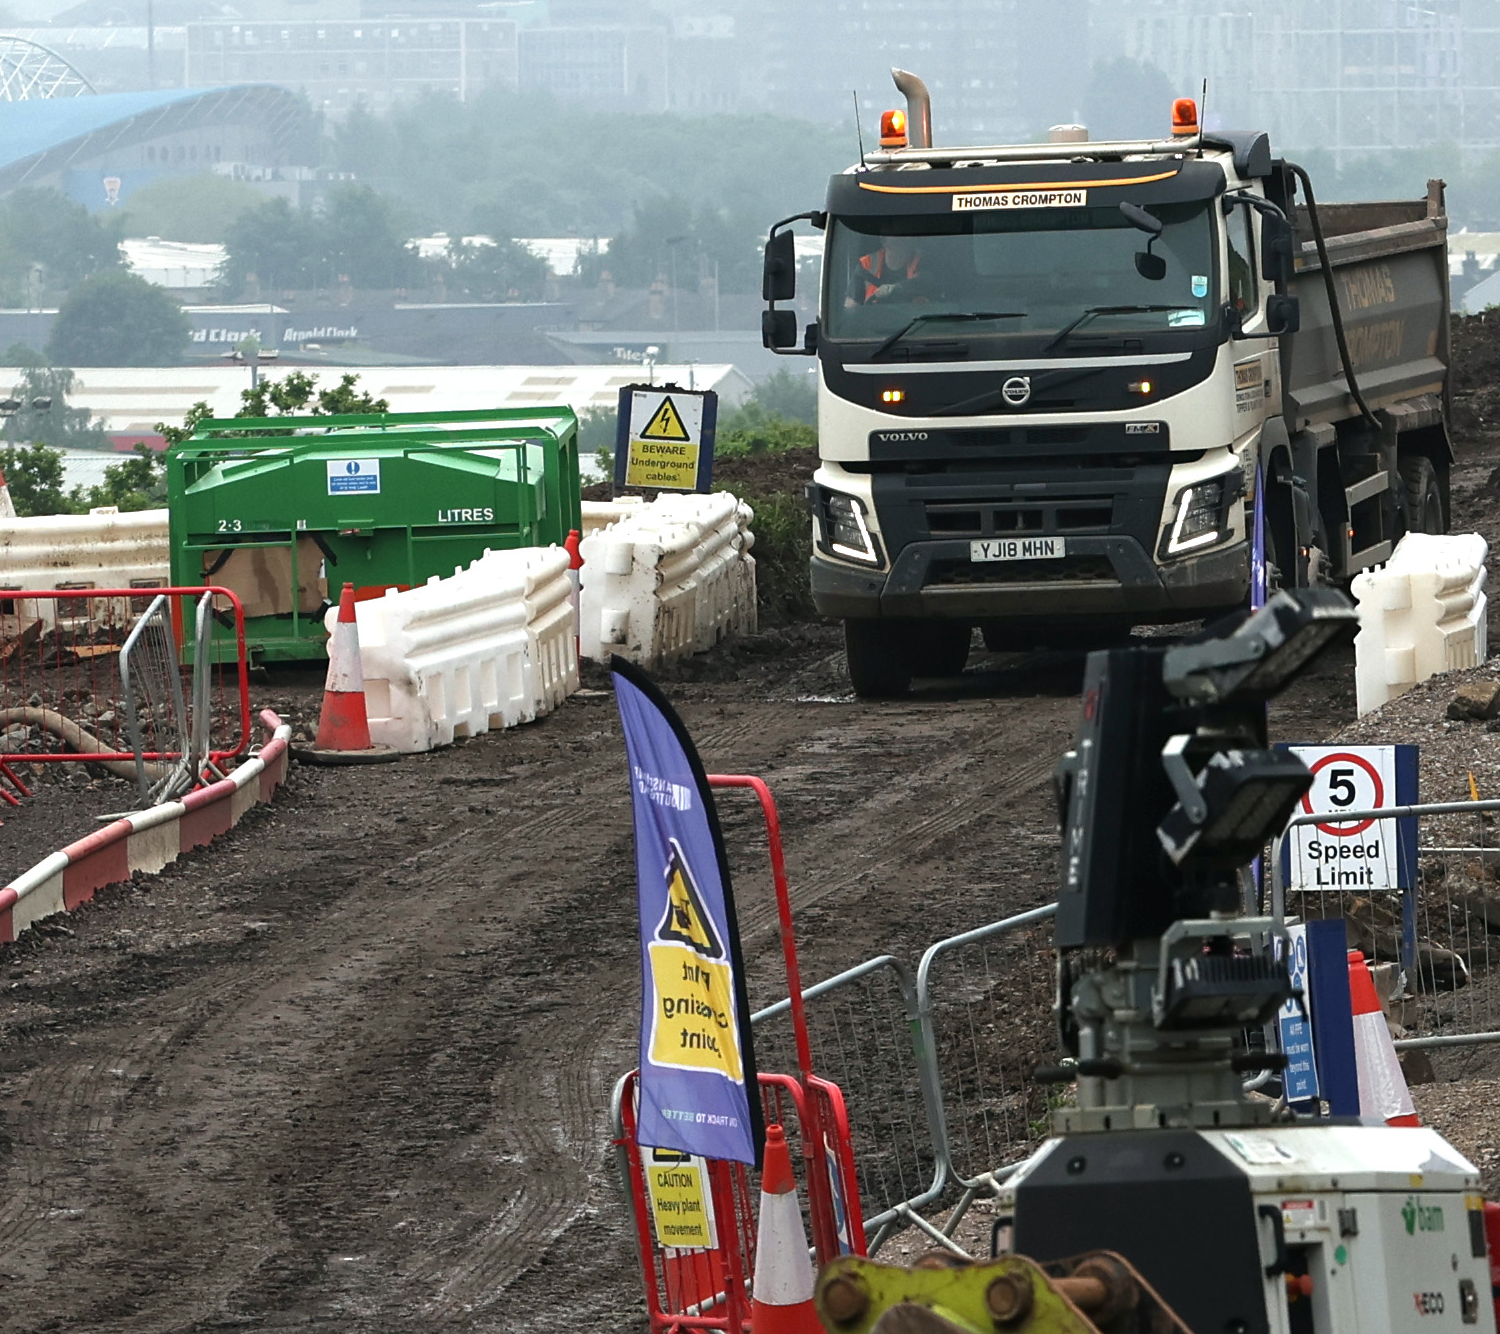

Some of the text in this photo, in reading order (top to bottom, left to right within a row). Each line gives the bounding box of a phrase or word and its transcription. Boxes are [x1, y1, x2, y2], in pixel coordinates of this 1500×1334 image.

[956, 192, 1082, 208] THOMAS CROMPTON
[209, 328, 262, 343] Clark
[283, 327, 326, 342] Arnold
[878, 431, 929, 442] VOLVO
[641, 444, 687, 456] BEWARE
[631, 457, 695, 470] Underground
[645, 472, 678, 482] cables
[438, 507, 494, 522] LITRES
[981, 540, 1055, 558] YJ18 MHN
[1328, 769, 1356, 807] 5
[1307, 839, 1380, 864] Speed
[1316, 866, 1374, 886] Limit
[657, 1173, 693, 1188] CAUTION
[656, 1198, 702, 1216] Heavy plant
[663, 1223, 703, 1237] movement
